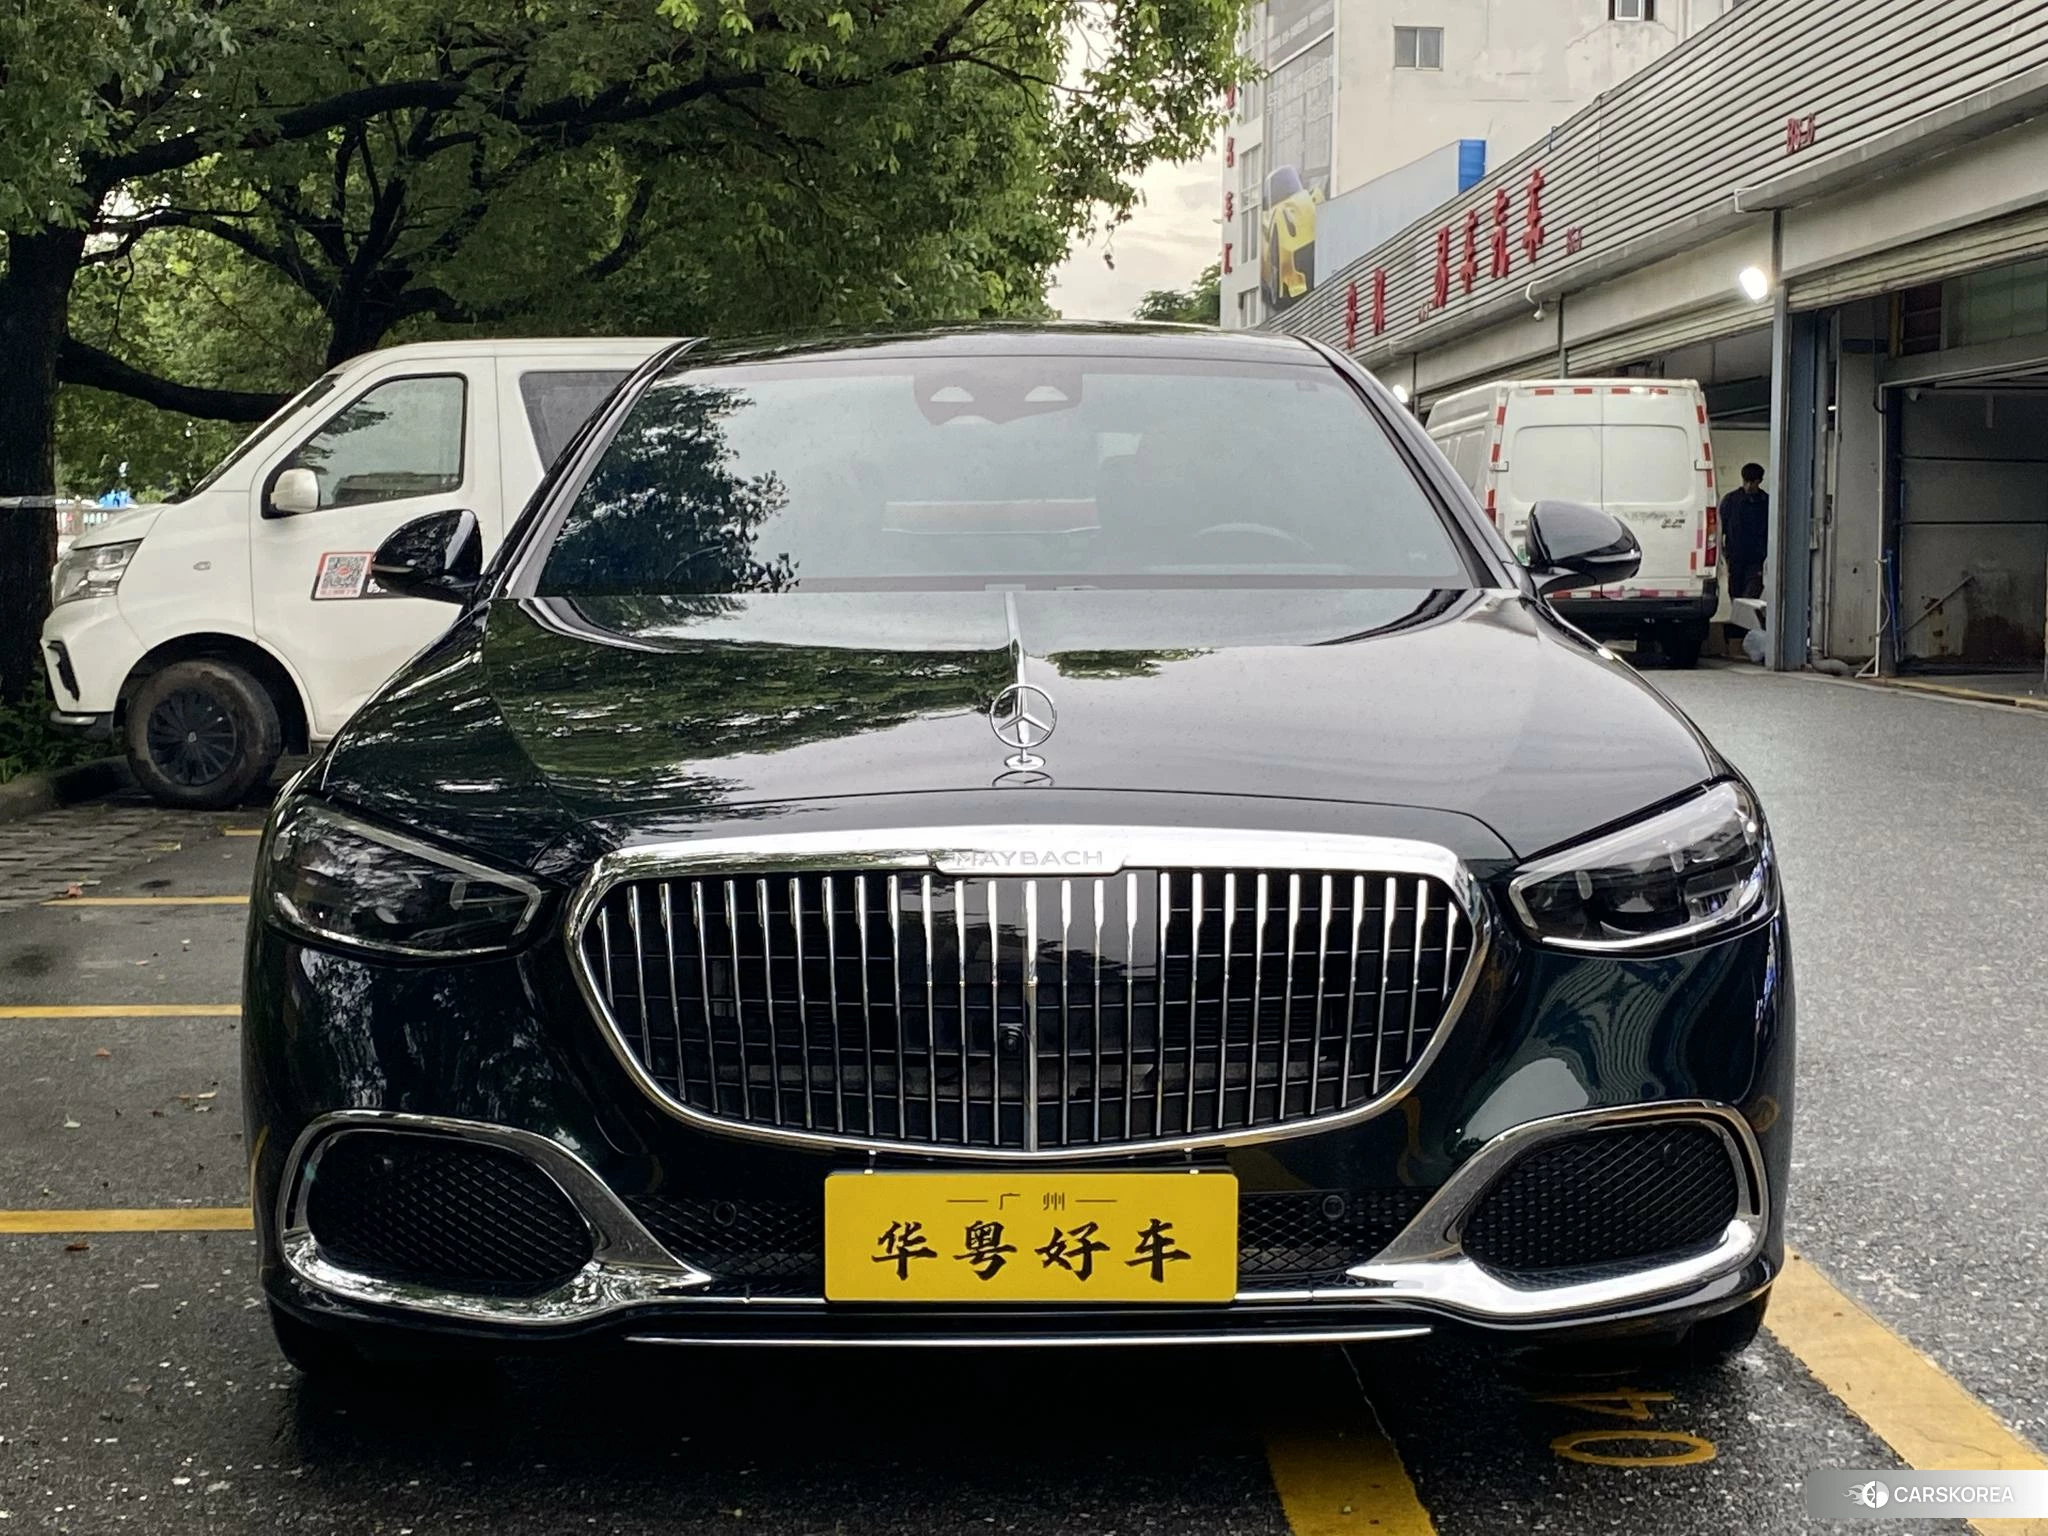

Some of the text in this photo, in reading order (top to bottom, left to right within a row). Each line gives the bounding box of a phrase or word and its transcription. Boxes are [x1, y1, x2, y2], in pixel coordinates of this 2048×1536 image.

[956, 851, 1103, 867] MAYBACH
[1000, 1192, 1065, 1210] 广州
[871, 1218, 1192, 1284] 华粤好车
